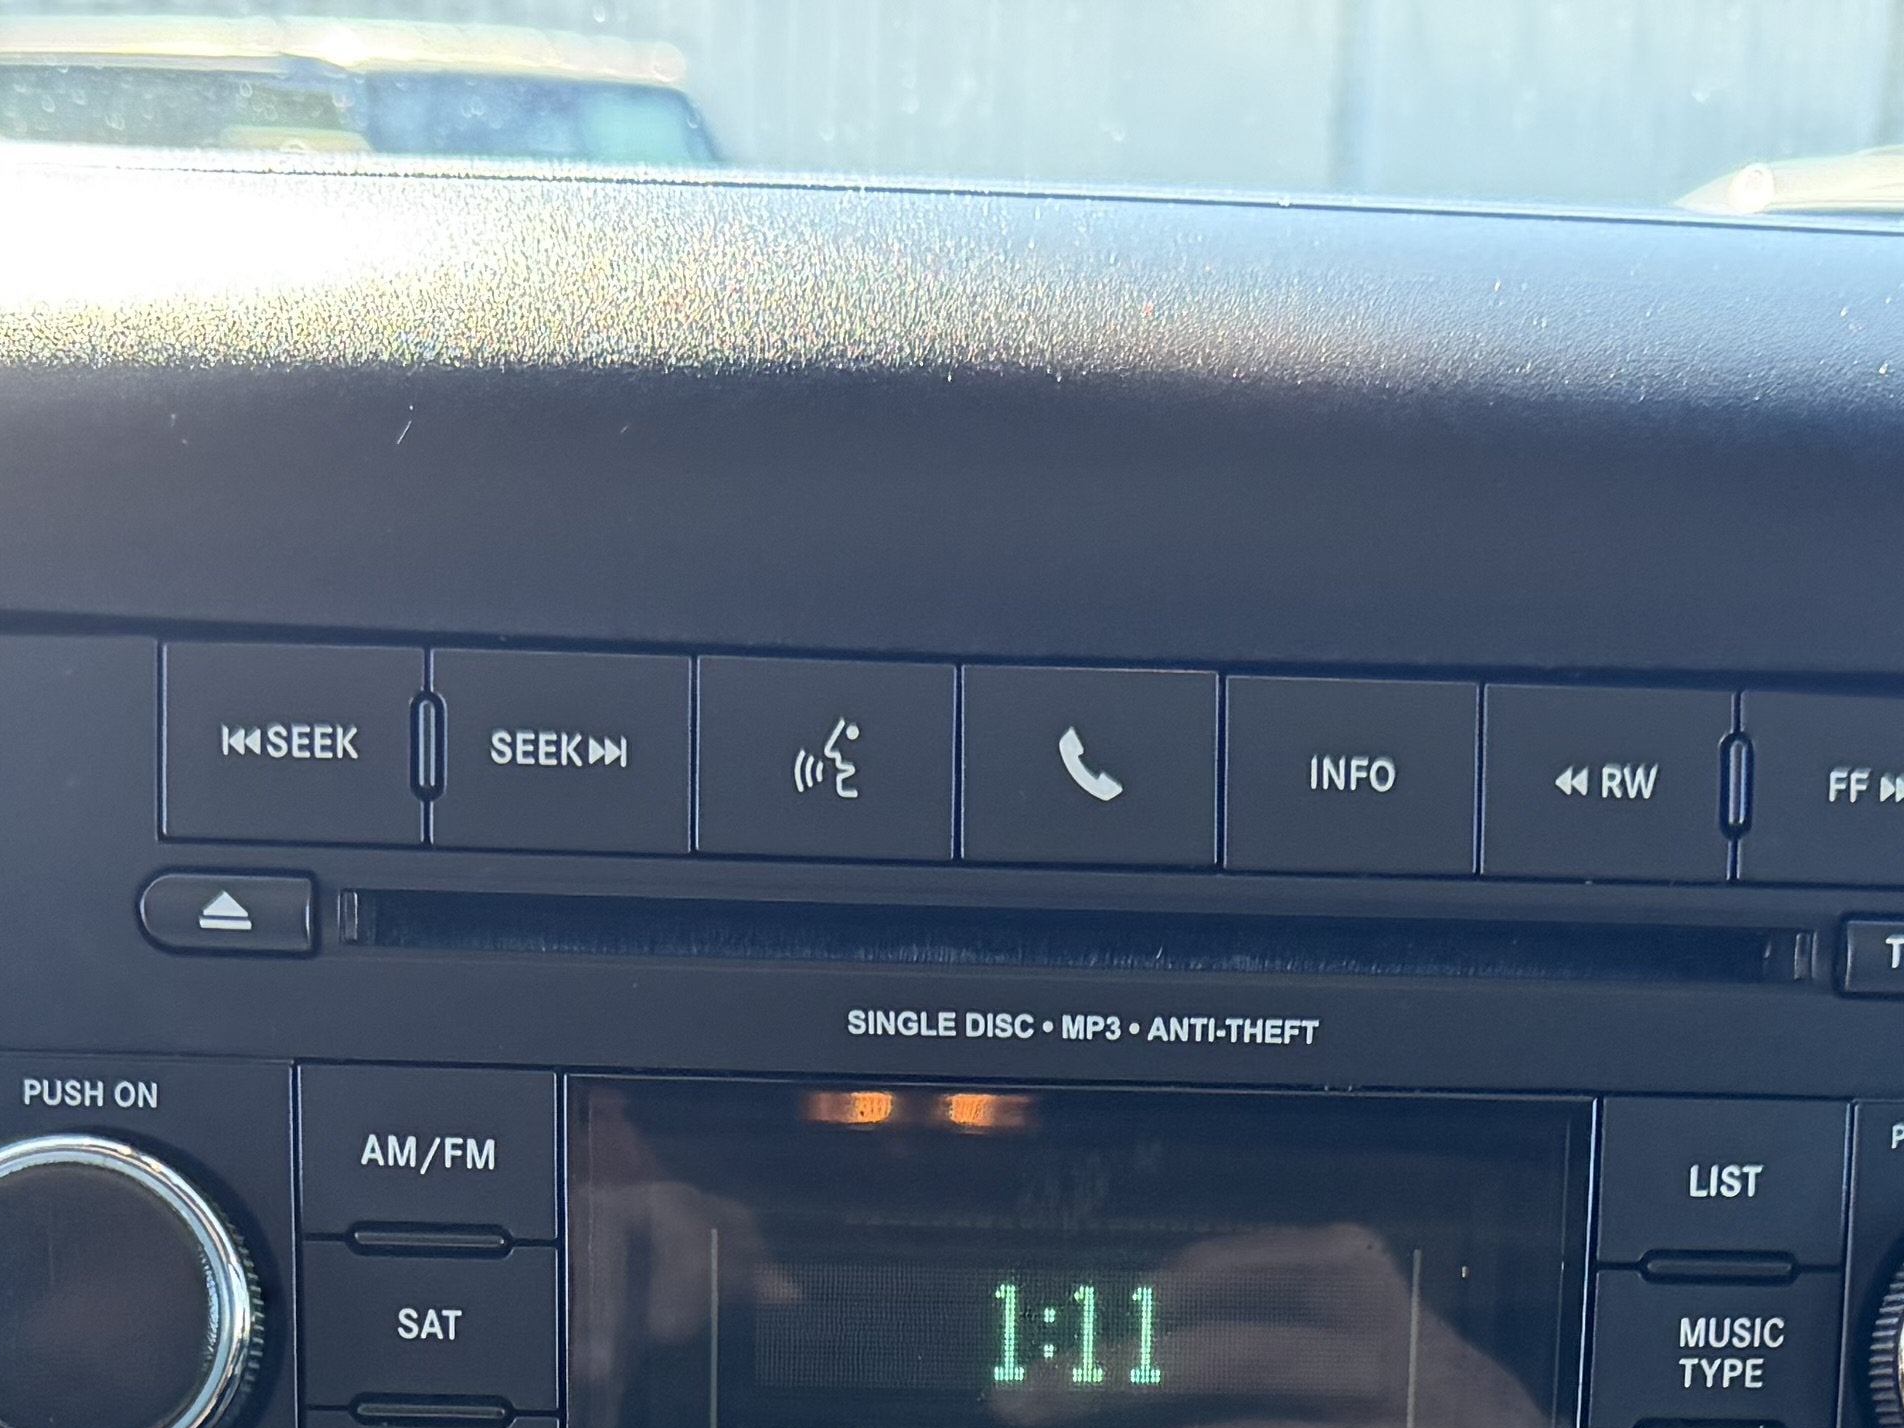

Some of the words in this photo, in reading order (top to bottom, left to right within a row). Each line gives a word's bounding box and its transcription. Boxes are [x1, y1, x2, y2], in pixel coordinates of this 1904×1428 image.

[266, 725, 358, 760] SEEK
[491, 731, 582, 766] SEEK
[1311, 756, 1395, 792] INFO
[1602, 765, 1657, 799] RW
[1829, 770, 1868, 802] FF
[848, 1010, 956, 1036] SINGLE
[966, 1013, 1034, 1038] DISC
[1062, 1015, 1121, 1040] MP3
[1148, 1017, 1319, 1044] ANTI-THEFT
[24, 1079, 103, 1106] PUSH
[115, 1081, 157, 1108] ON
[361, 1134, 494, 1174] AM/FM
[1690, 1165, 1763, 1197] LIST
[398, 1308, 462, 1340] SAT
[994, 1284, 1160, 1384] 1:11
[1680, 1318, 1784, 1348] MUSIC
[1679, 1358, 1763, 1387] TYPE
